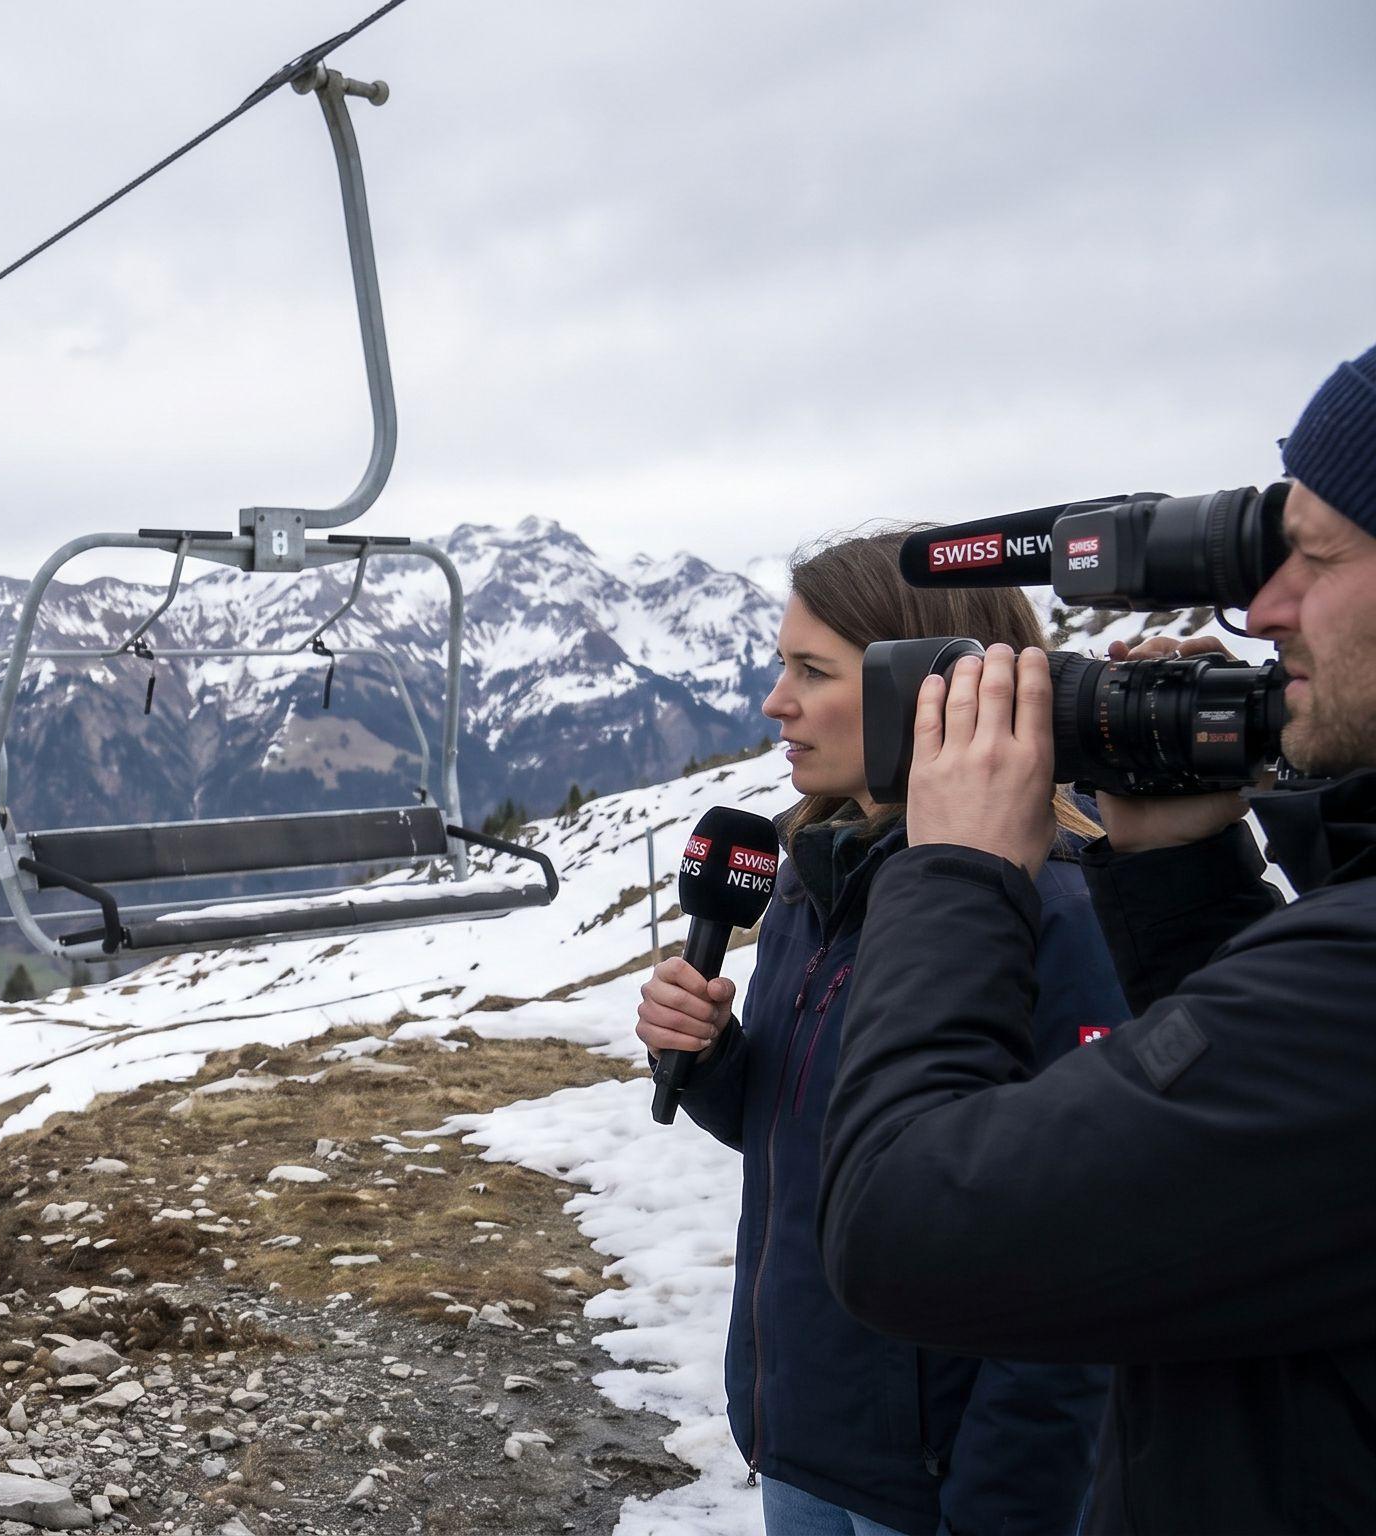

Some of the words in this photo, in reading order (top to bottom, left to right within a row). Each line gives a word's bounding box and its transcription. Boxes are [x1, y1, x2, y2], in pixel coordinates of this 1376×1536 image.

[933, 540, 999, 565] SWISS
[733, 852, 776, 873] SWISS
[727, 870, 773, 893] NEWS
